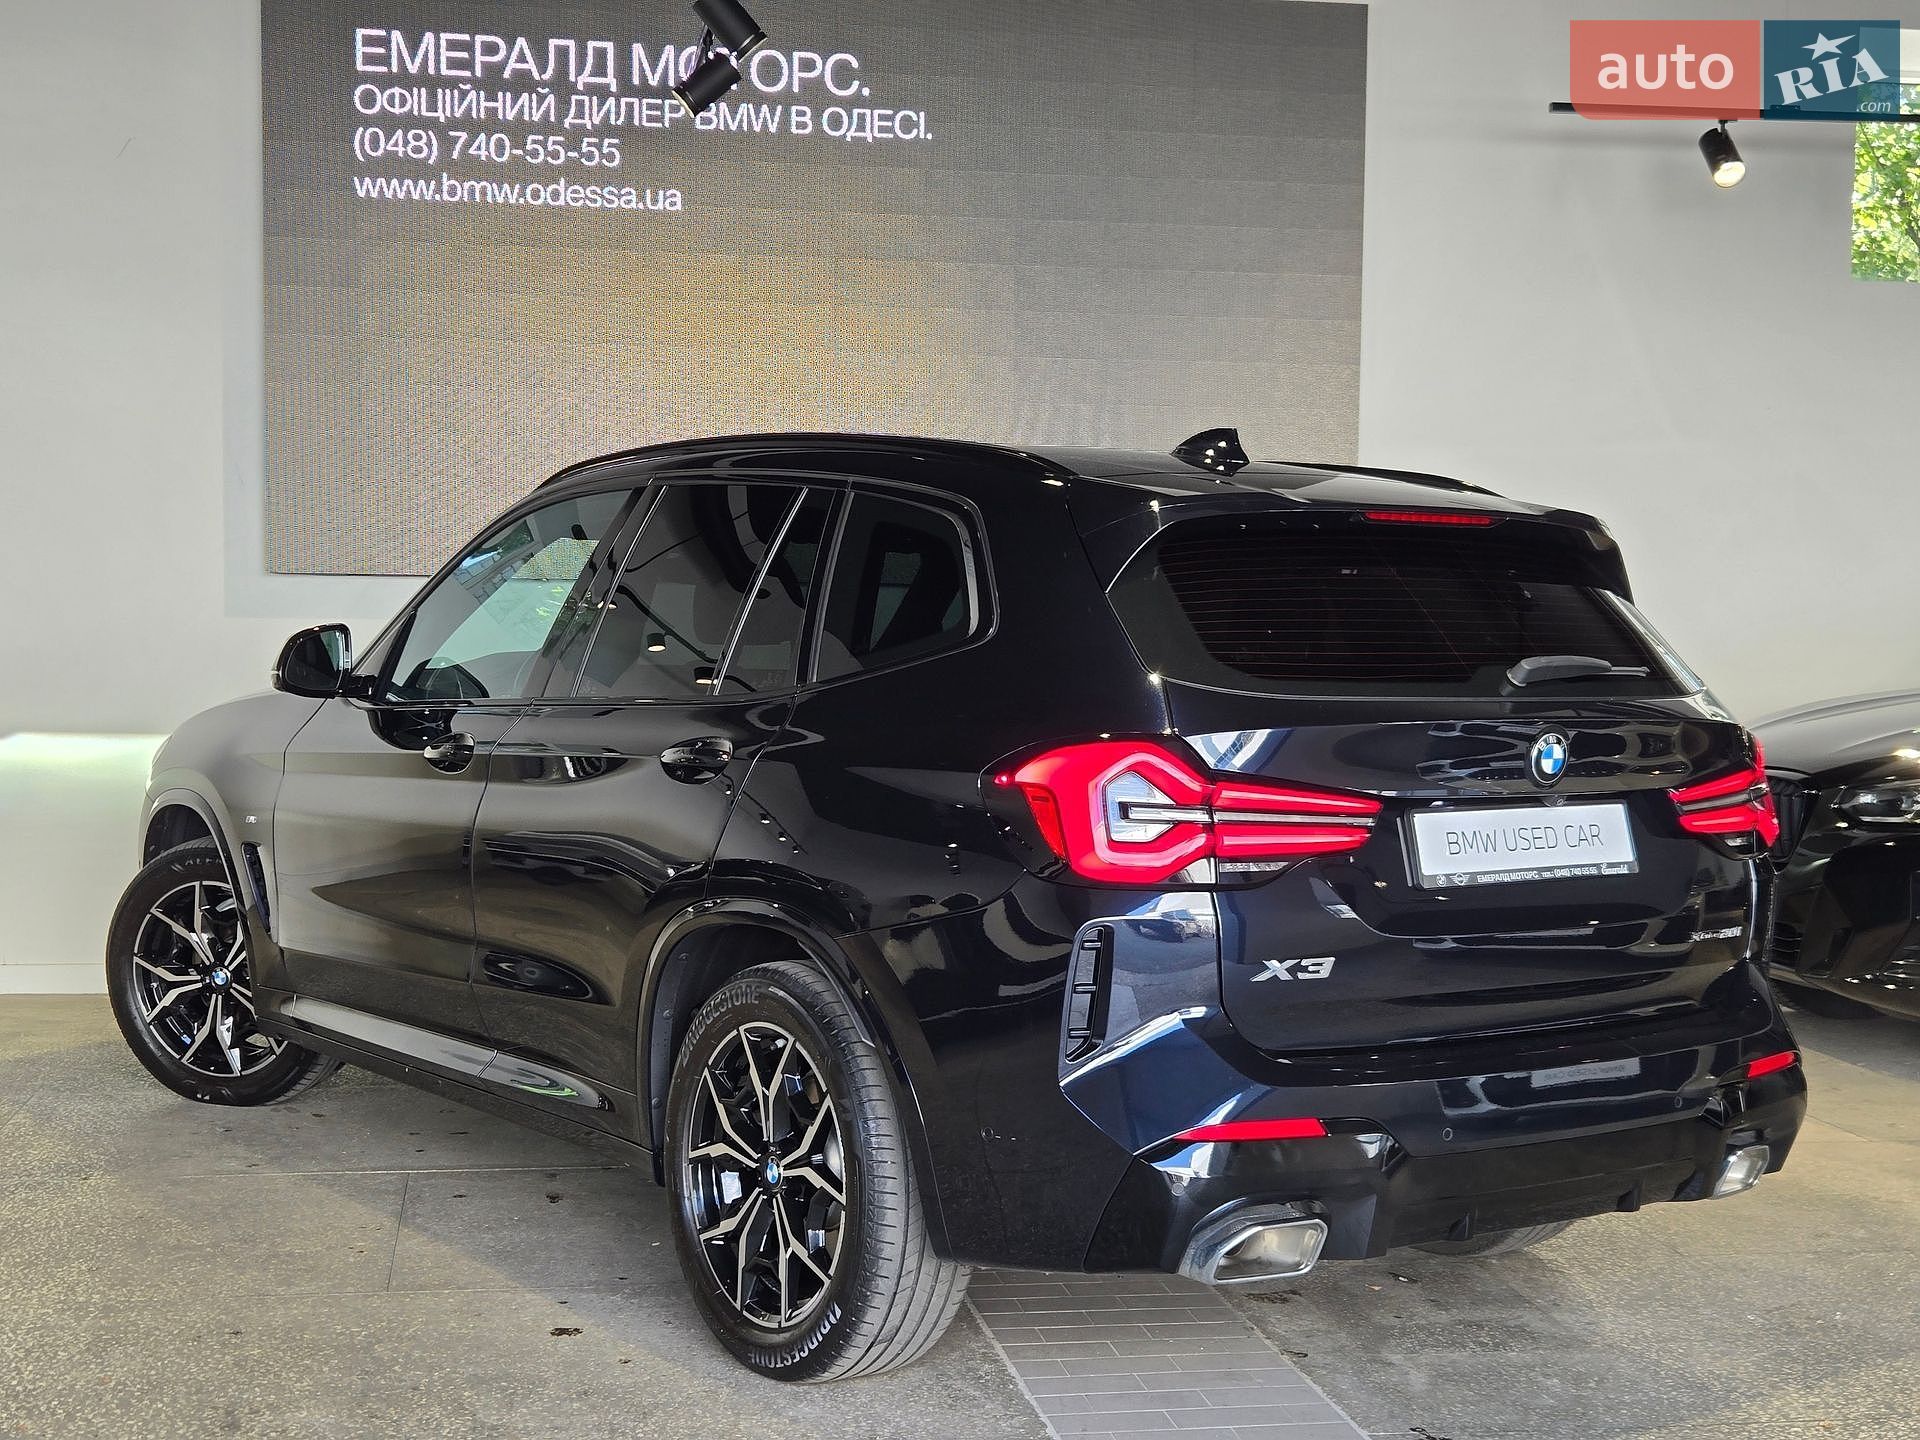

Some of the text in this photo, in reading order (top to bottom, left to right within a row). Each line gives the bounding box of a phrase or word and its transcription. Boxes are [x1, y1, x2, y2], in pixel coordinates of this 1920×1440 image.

[355, 28, 617, 92] ЕМЕРАЛД
[353, 83, 555, 122] ОФІЦІЙНИЙ
[564, 94, 686, 130] ДИЛЕР
[695, 101, 782, 134] BMW
[822, 107, 933, 143] ОДЕСІ.
[353, 126, 621, 167] (048) 740-55-55
[353, 172, 682, 211] www.bmw.odessa.ua
[1446, 823, 1604, 856] BMW USED CAR
[1249, 956, 1336, 982] X3
